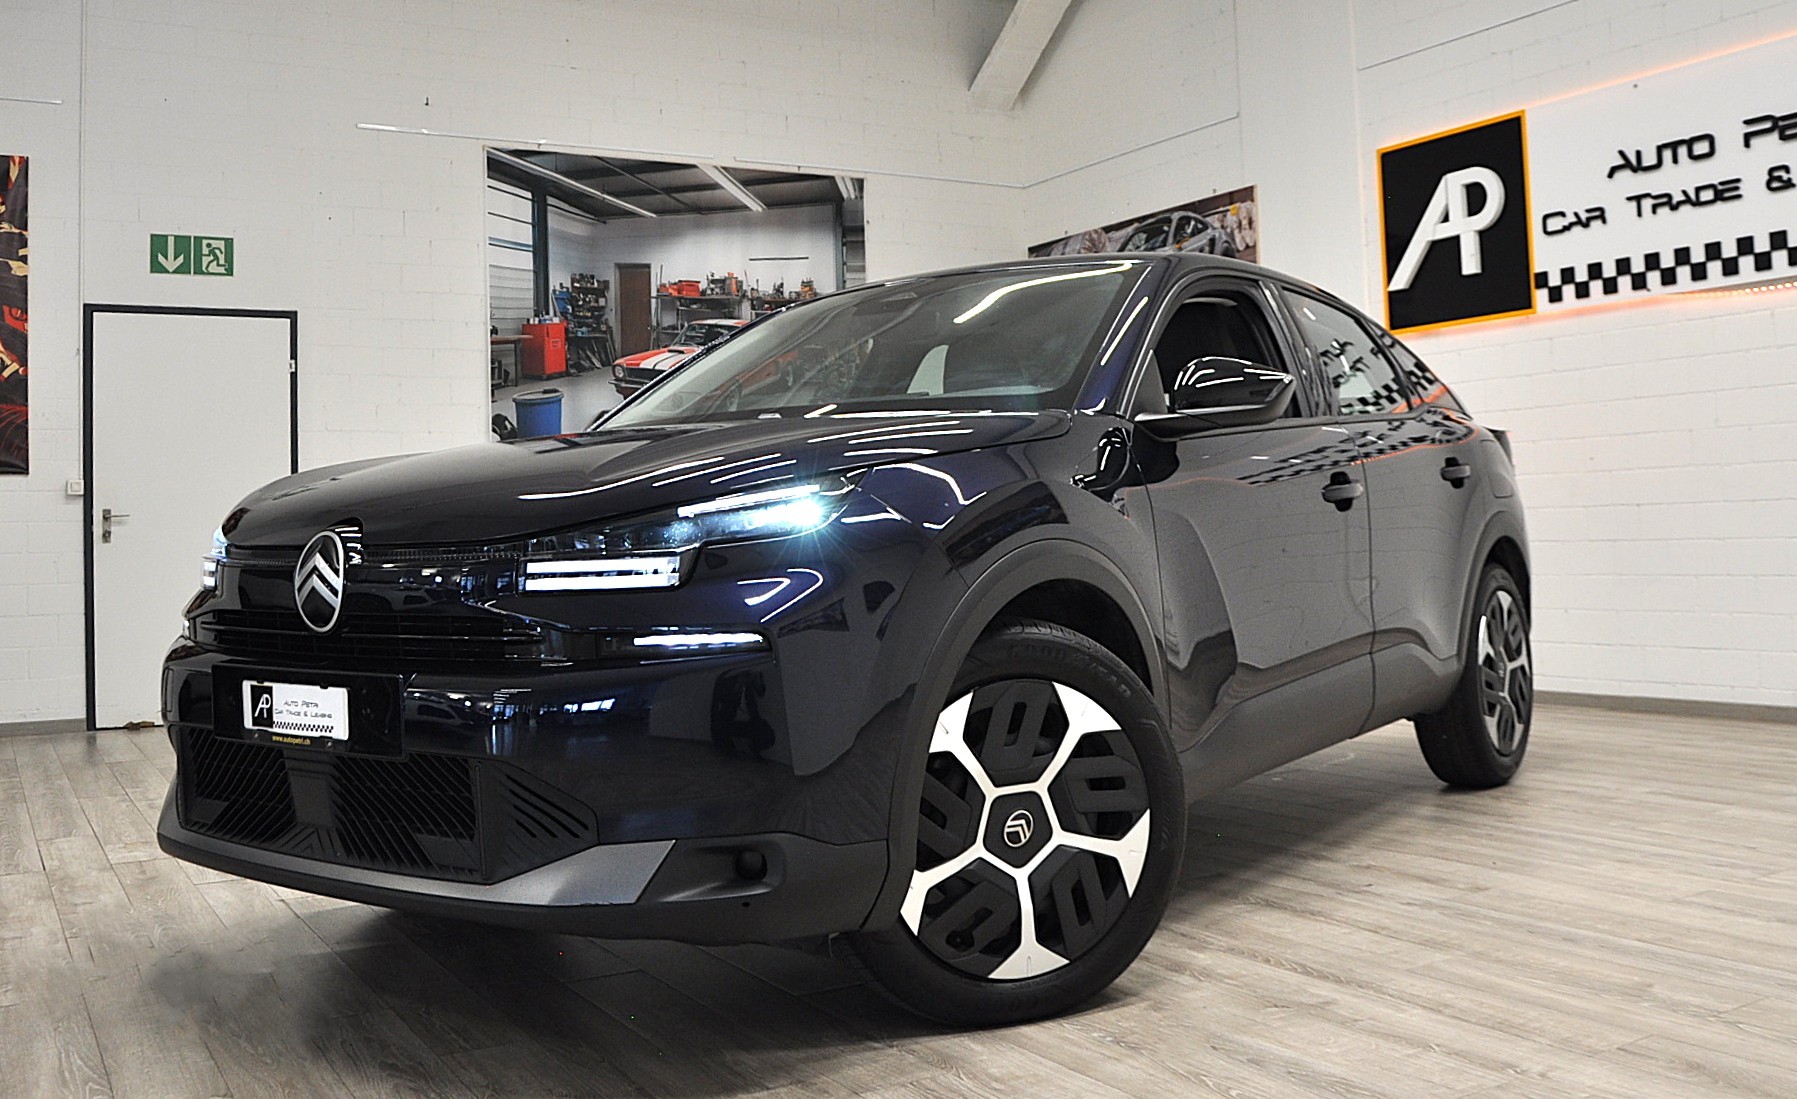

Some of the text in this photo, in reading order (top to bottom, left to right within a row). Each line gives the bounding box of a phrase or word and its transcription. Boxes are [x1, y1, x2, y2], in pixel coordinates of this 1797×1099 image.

[1607, 133, 1716, 179] AUTO
[1542, 164, 1796, 236] CAR TRADE &
